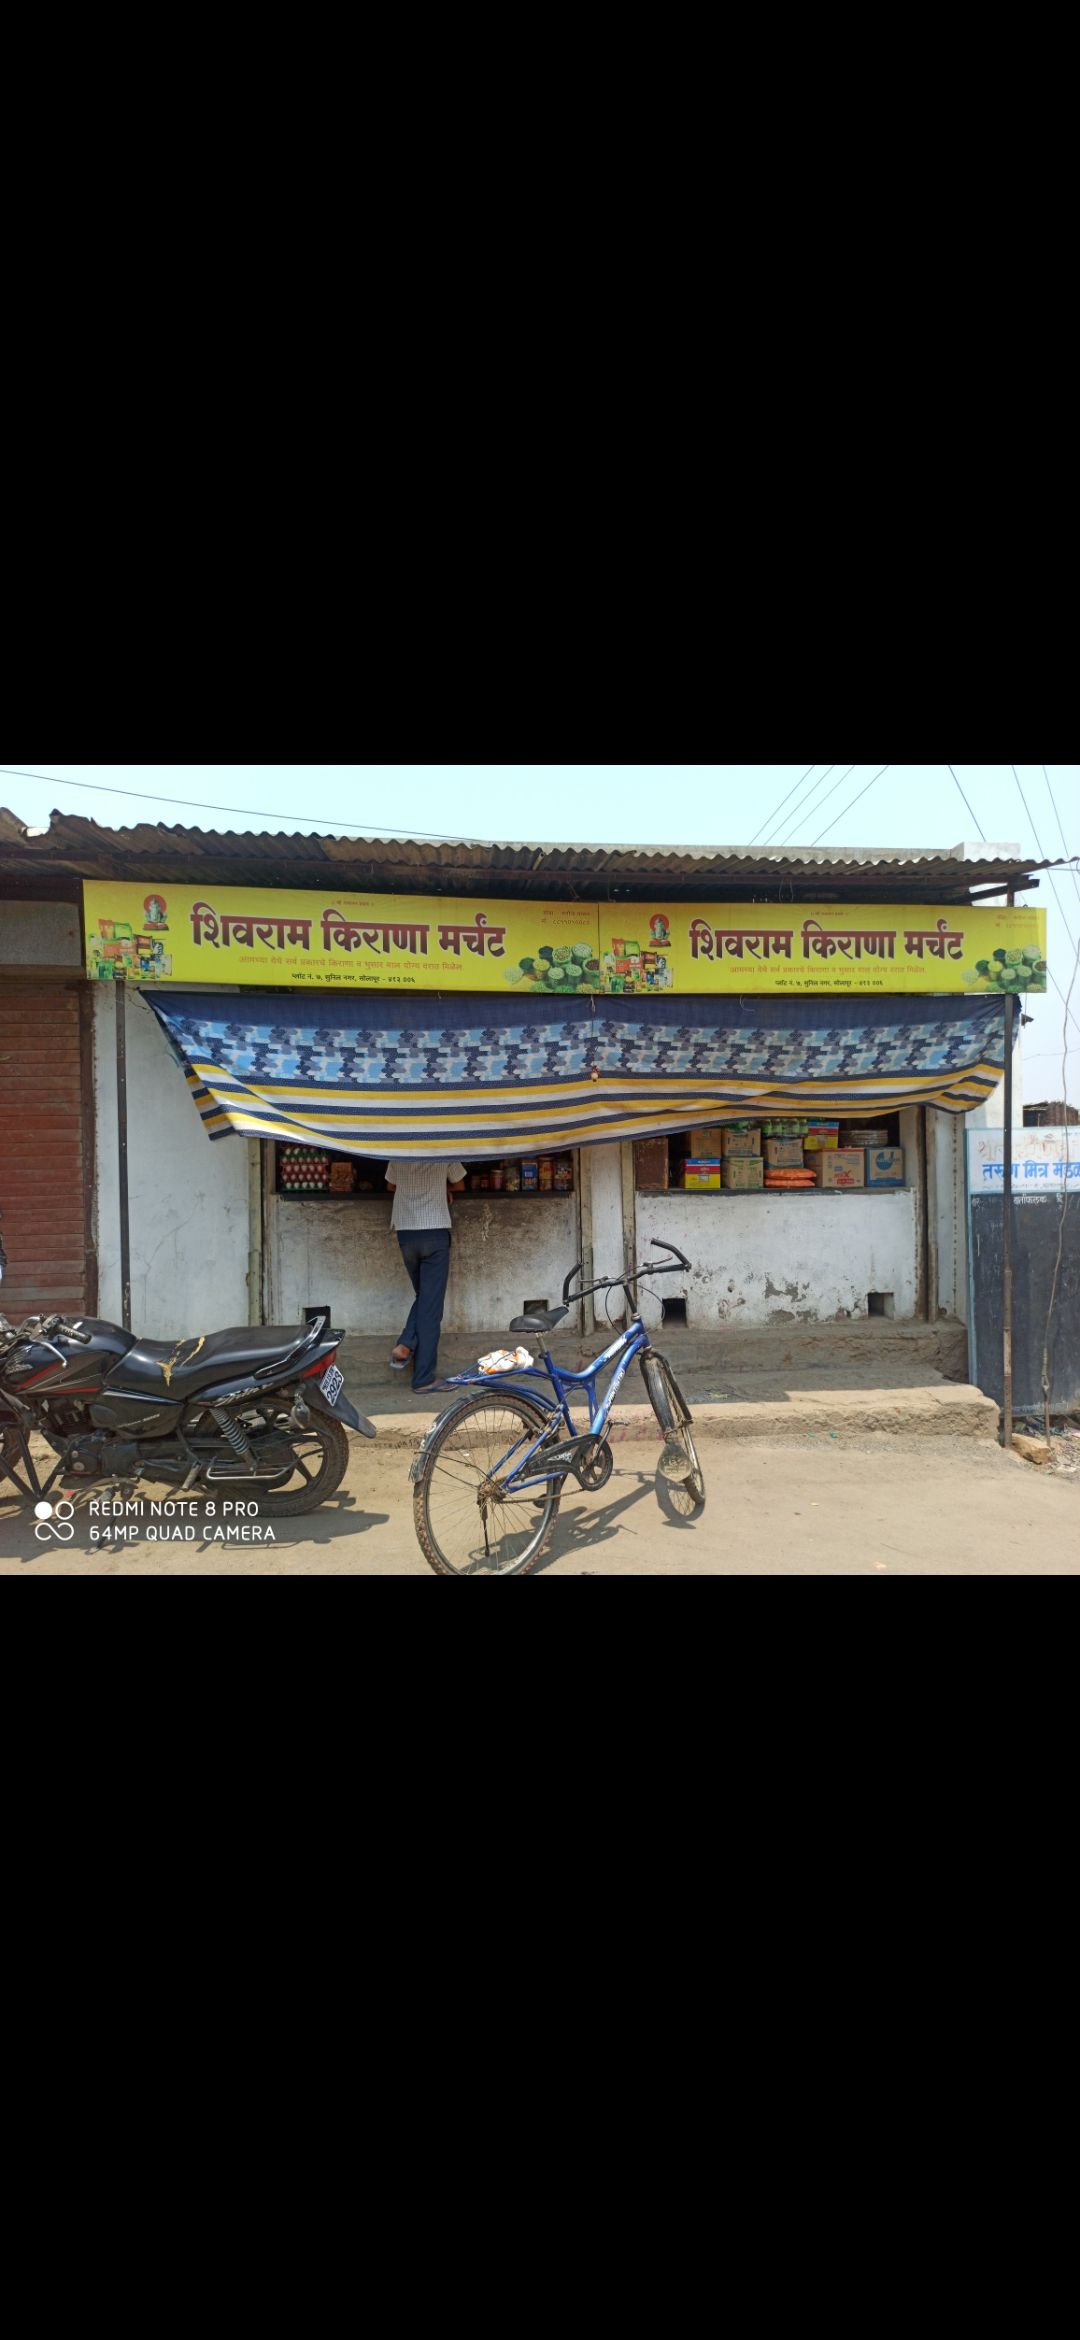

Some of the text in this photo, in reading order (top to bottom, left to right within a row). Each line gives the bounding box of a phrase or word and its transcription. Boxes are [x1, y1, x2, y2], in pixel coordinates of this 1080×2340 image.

[190, 902, 506, 958] शिवराम किराणा मर्चंट
[689, 918, 964, 961] शिवराम किराणा मर्चंट
[1024, 1160, 1049, 1178] मित्र
